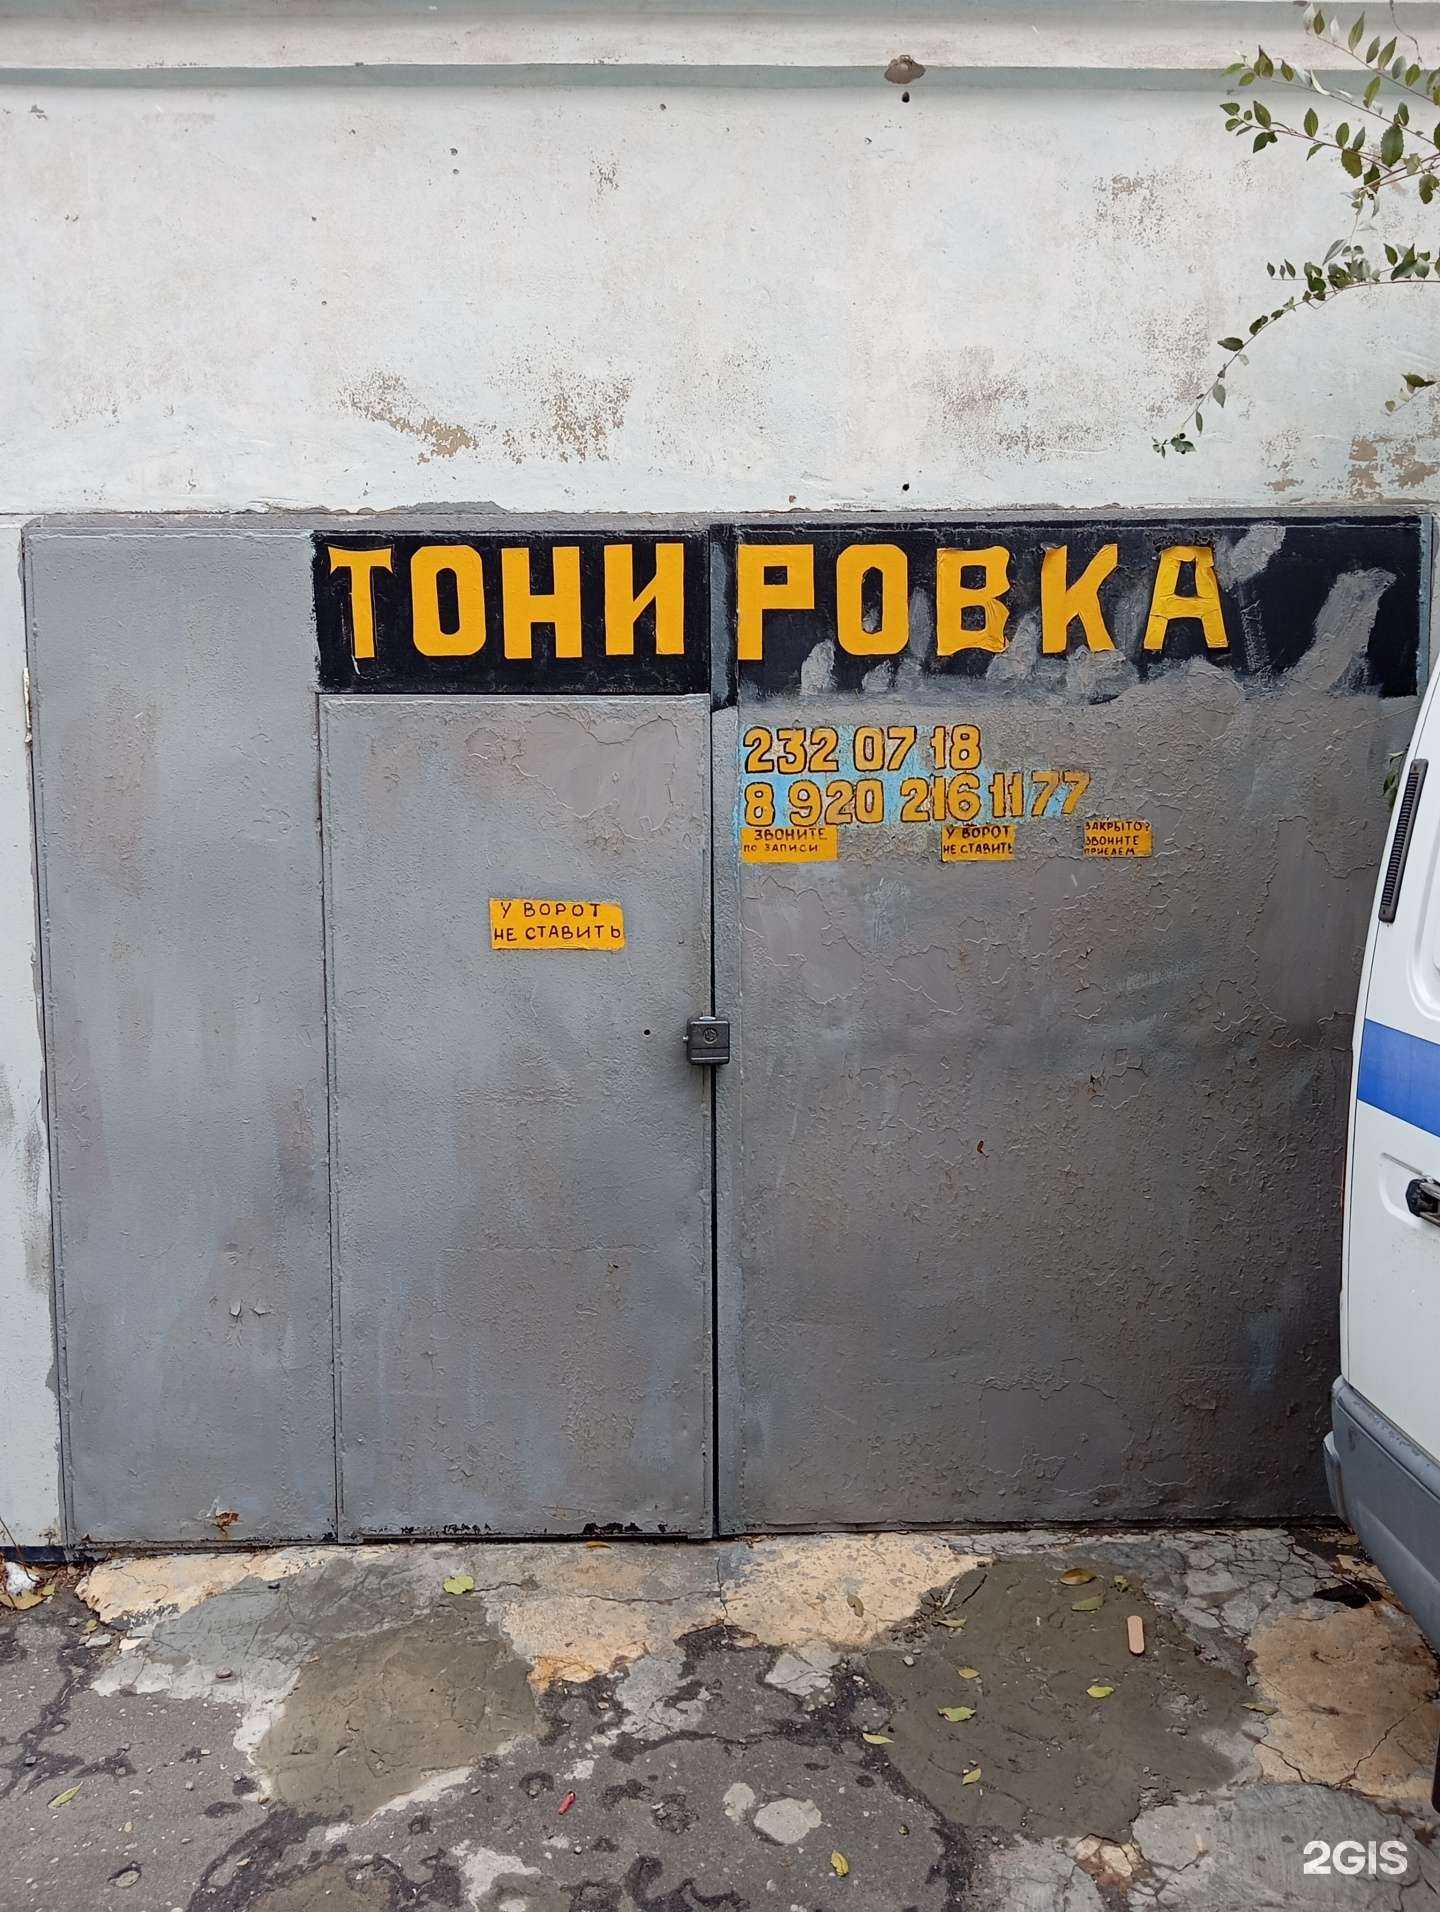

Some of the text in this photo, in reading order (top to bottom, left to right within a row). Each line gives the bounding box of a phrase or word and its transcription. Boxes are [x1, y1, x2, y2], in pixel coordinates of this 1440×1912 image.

[327, 543, 1229, 661] ТОНИРОВКА
[743, 724, 981, 774] 232 07 18
[744, 770, 1091, 827] 8 920 216 11 77
[754, 828, 828, 841] ЗВОНИТЕ
[947, 825, 1010, 839] У ВОРОТ
[765, 843, 818, 852] ЗАПИСИ
[1085, 835, 1139, 846] ЗВОНИТЕ
[943, 844, 956, 854] НЕ
[501, 901, 600, 918] У ВОРОТ
[494, 924, 621, 941] НЕ СТАВИТЬ
